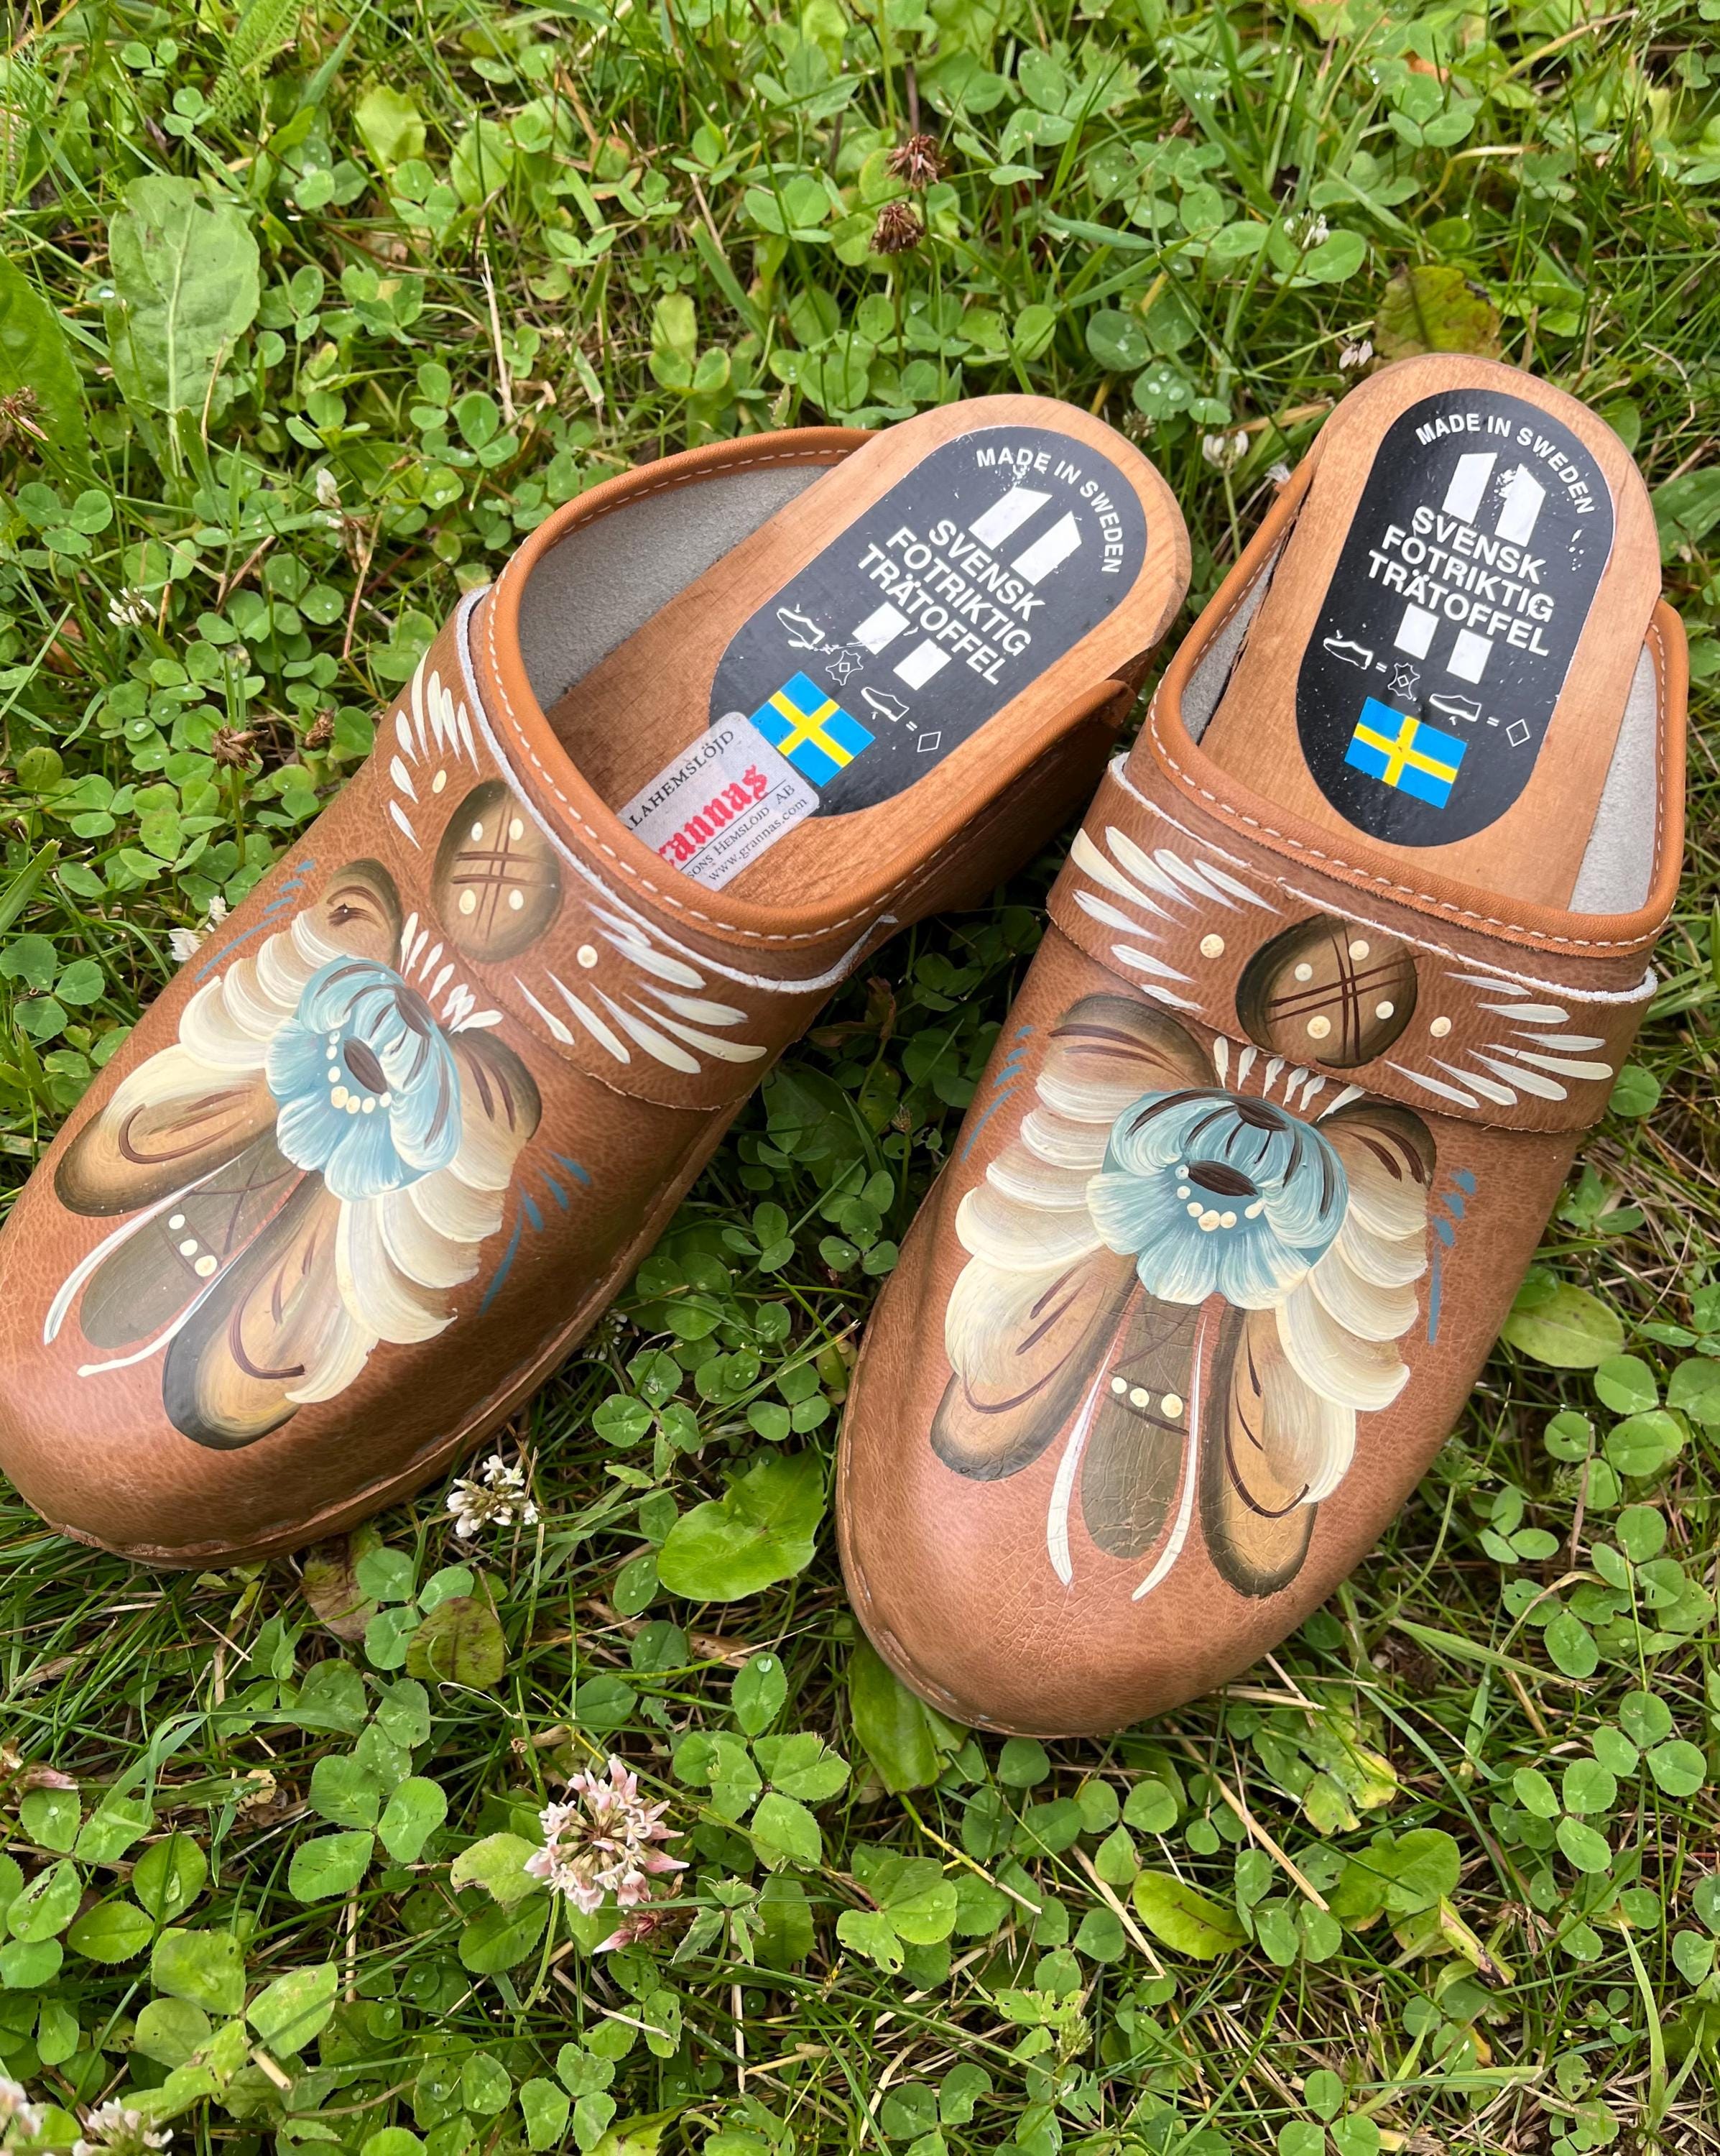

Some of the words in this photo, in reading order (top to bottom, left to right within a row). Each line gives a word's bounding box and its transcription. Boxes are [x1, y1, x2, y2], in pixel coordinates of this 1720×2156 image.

[976, 447, 1052, 468] MADE
[1054, 460, 1081, 485] IN
[1080, 480, 1124, 573] SWEDEN
[1415, 413, 1480, 446] MADE
[1487, 415, 1511, 437] IN
[1516, 427, 1595, 515] SWEDEN
[885, 525, 1032, 657] FOTRIKTIG
[928, 519, 1045, 622] SVENSK
[1381, 524, 1555, 622] FOTRIKTIG
[1411, 505, 1546, 585] SVENSK
[857, 543, 1006, 686] TRÄTOFFEL
[1368, 549, 1549, 657] TRÄTOFFEL
[626, 729, 734, 831] LAHEMSLÖJD
[712, 806, 770, 855] HEMSLÖJD
[775, 784, 795, 804] AB
[708, 798, 808, 882] www.grannas.com
